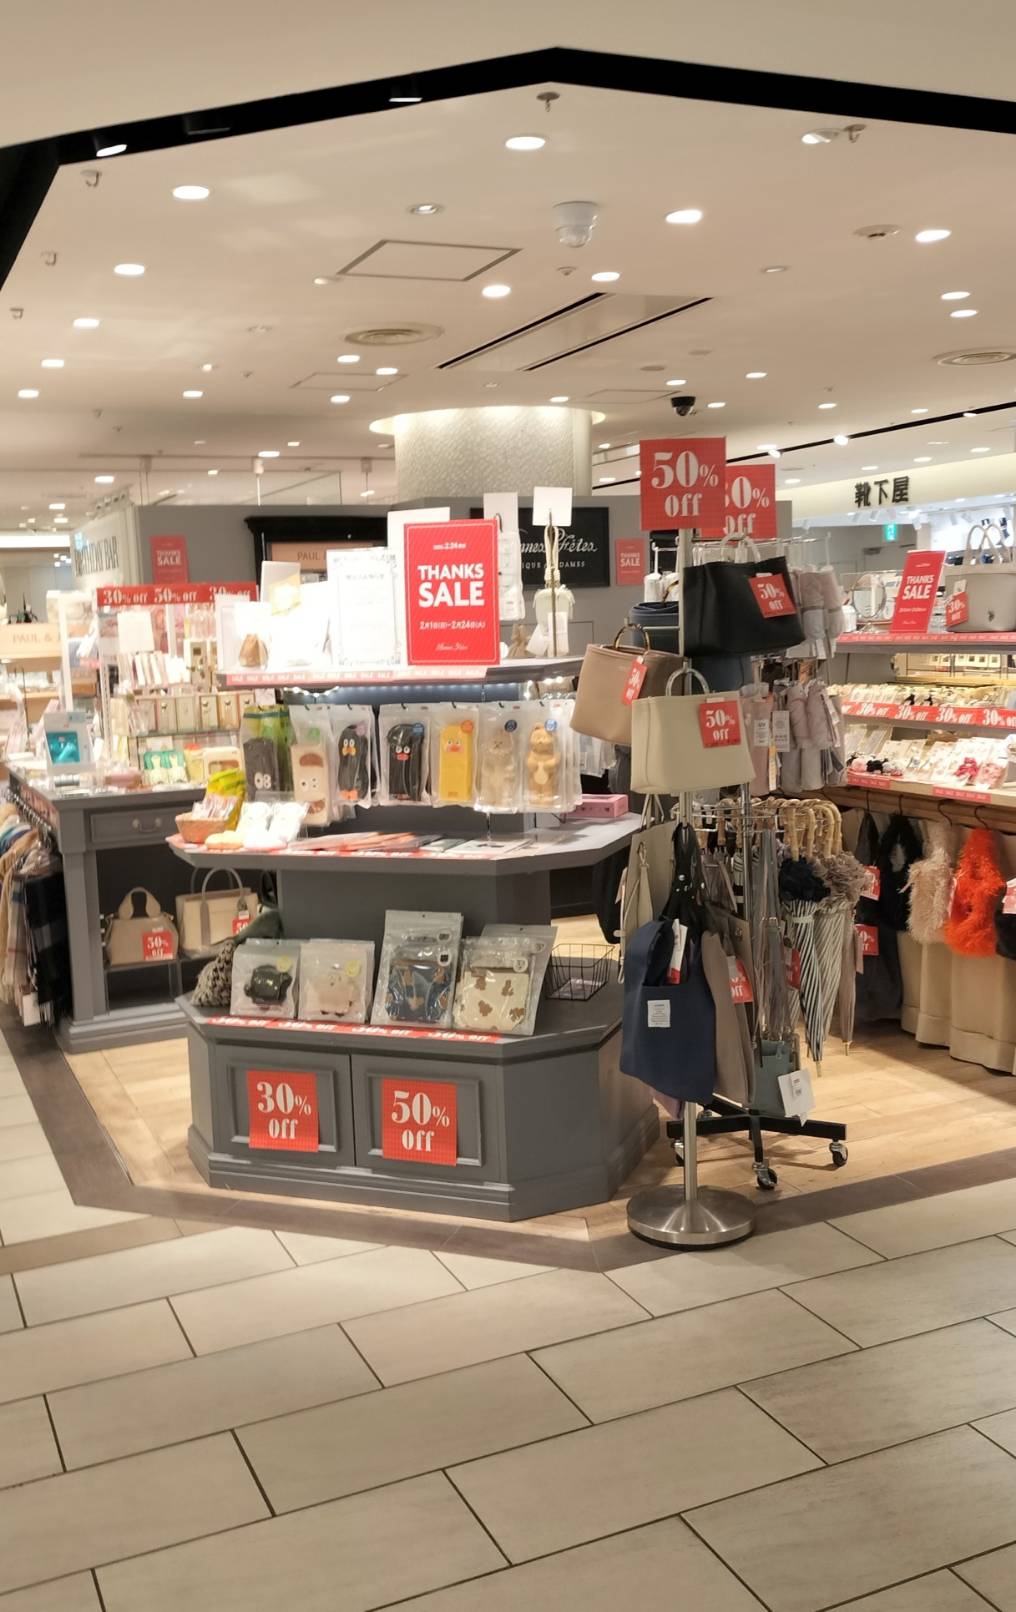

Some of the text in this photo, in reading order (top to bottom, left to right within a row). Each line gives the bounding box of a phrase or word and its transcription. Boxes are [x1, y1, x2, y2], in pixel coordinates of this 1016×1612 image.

[651, 450, 719, 489] 50%
[725, 476, 769, 510] 0%
[855, 476, 909, 508] 靴下屋
[664, 493, 702, 518] off
[157, 557, 181, 566] SALE
[297, 551, 320, 561] PAUL
[620, 558, 640, 567] SALE
[417, 563, 485, 580] THANKS
[907, 575, 935, 585] THANKS
[183, 591, 197, 602] off
[418, 581, 485, 608] SALE
[757, 583, 785, 599] 50%
[902, 585, 932, 600] SALE
[705, 709, 736, 728] 50%
[935, 706, 957, 722] 30%
[982, 709, 1005, 726] 30%
[713, 728, 729, 741] off
[257, 1081, 312, 1116] 30%
[391, 1090, 450, 1128] 50%
[269, 1118, 298, 1139] off
[402, 1129, 435, 1152] off
